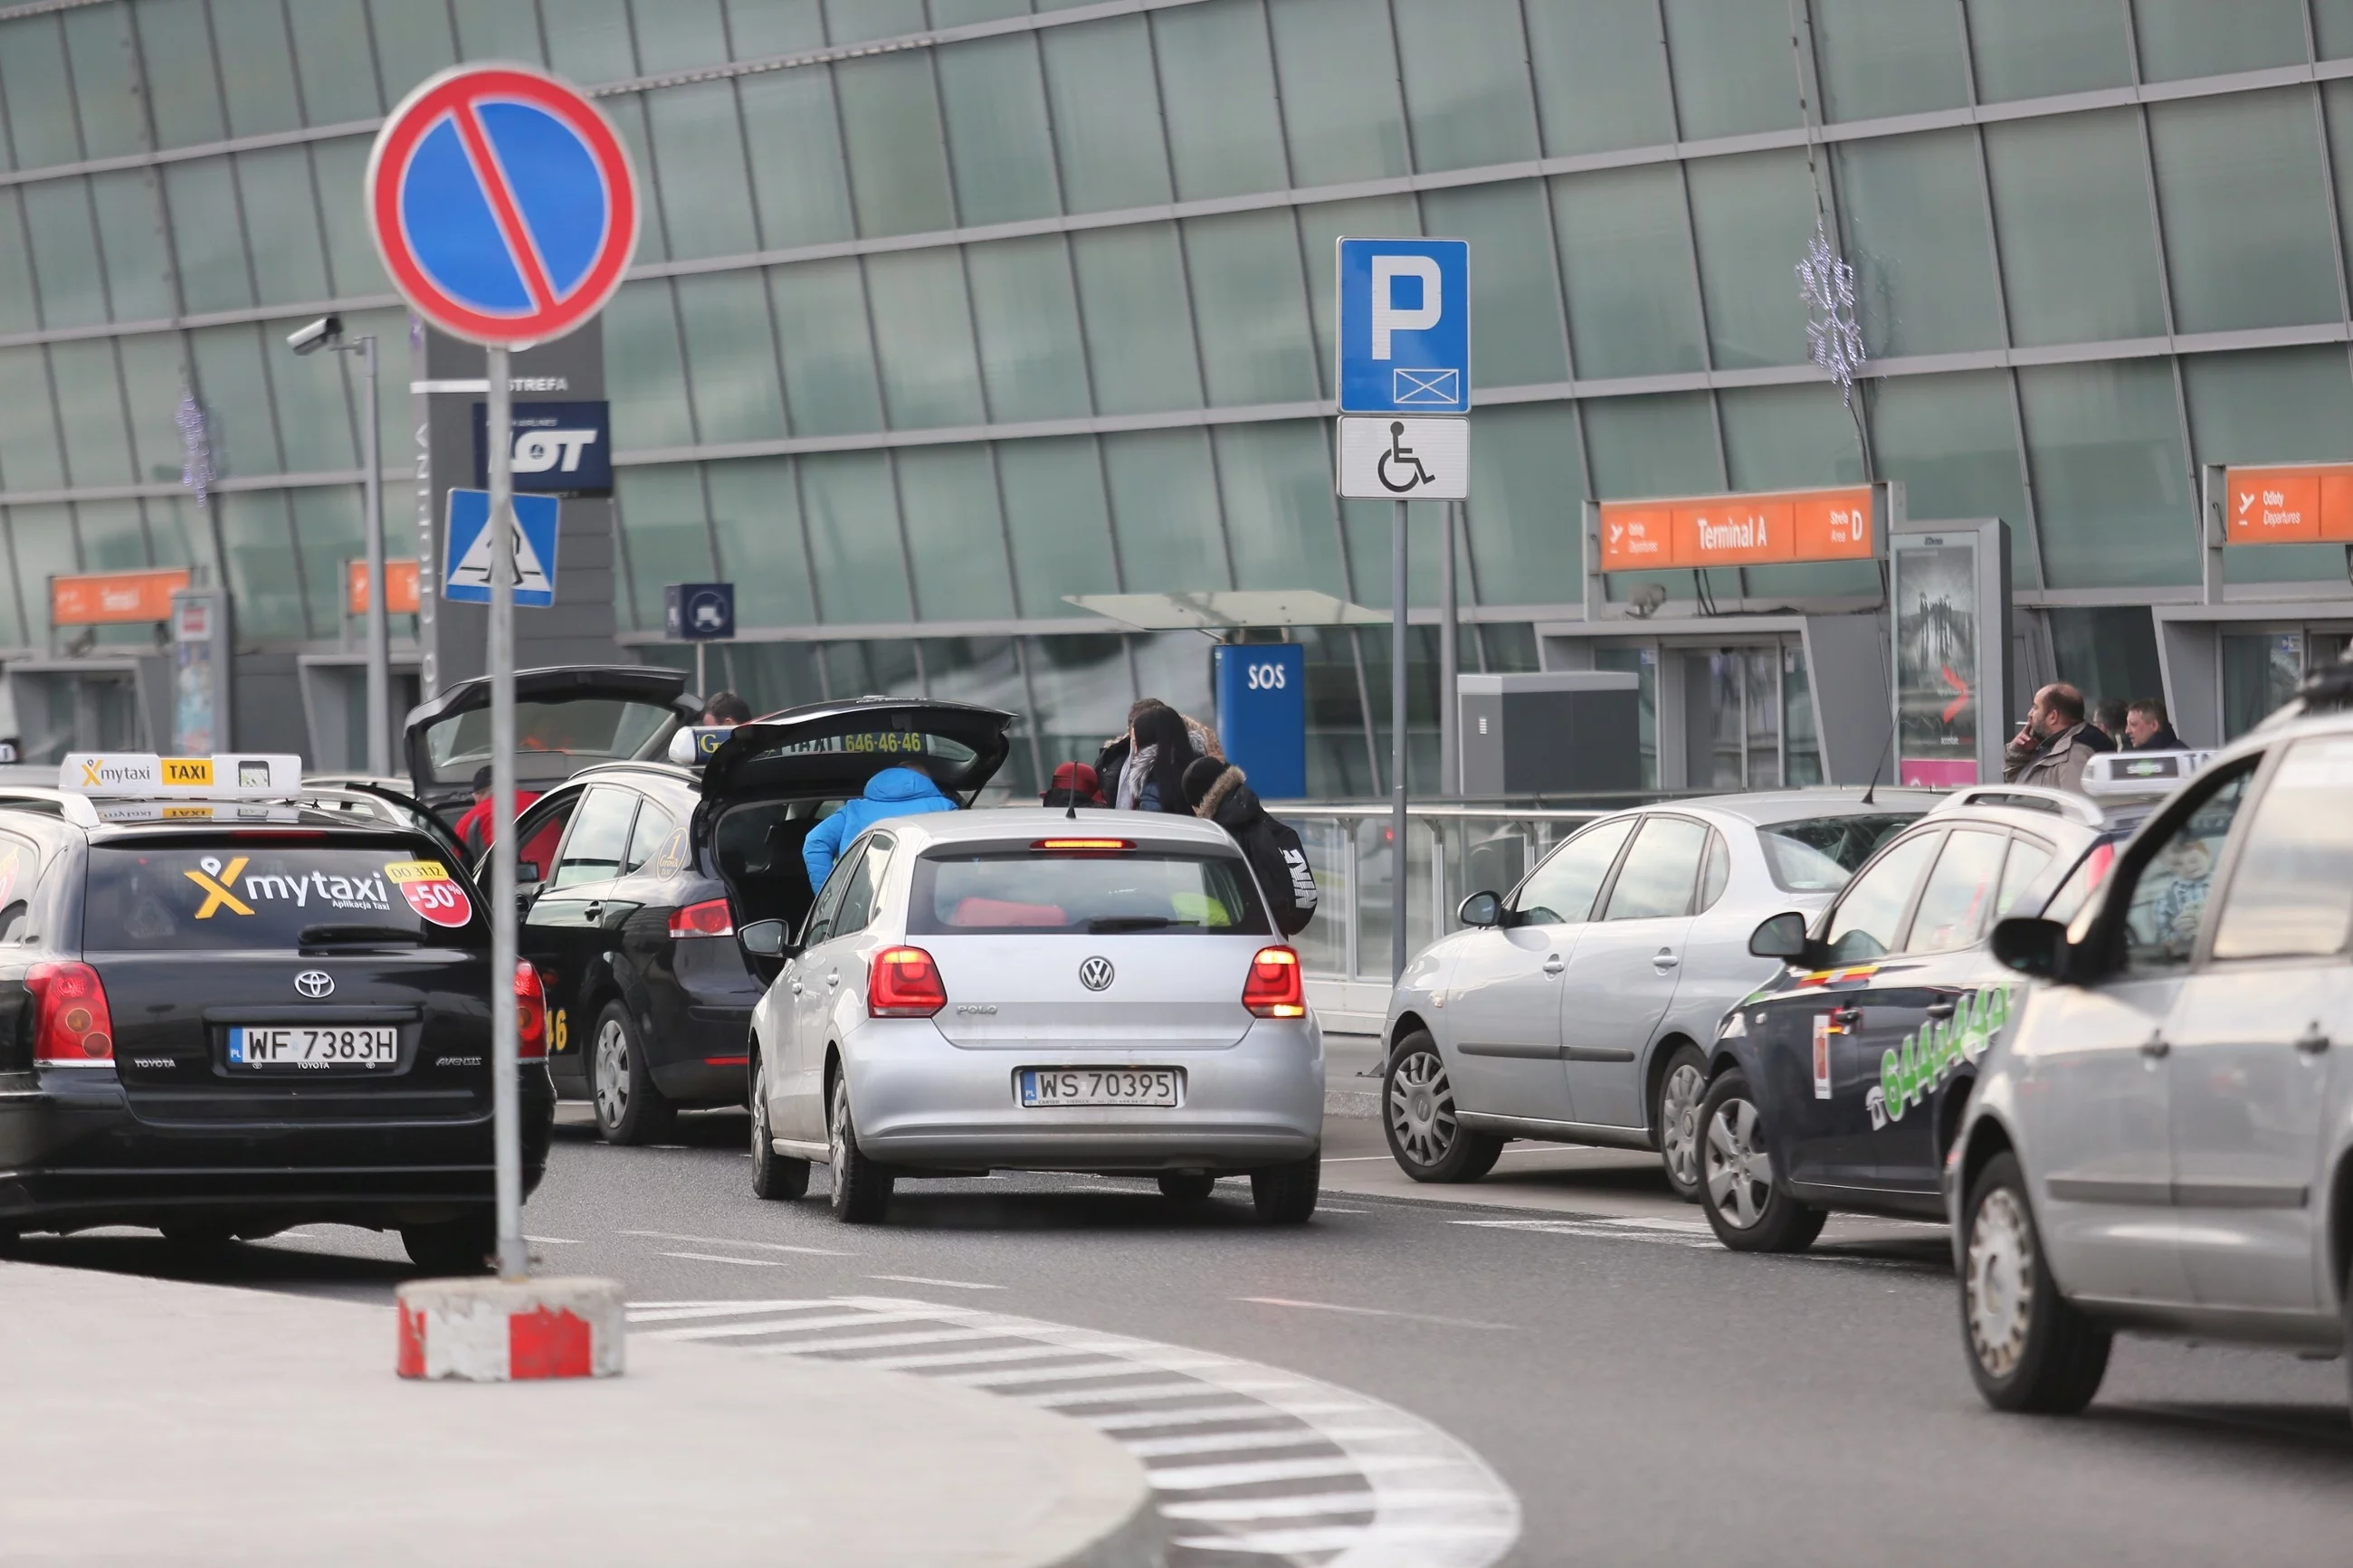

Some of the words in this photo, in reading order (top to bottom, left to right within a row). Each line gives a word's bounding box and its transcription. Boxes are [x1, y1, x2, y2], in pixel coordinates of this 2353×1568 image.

[1372, 255, 1442, 360] P
[1697, 517, 1754, 550] Terminal
[1757, 515, 1767, 547] A
[1852, 508, 1863, 541] D
[1248, 664, 1285, 689] SOS
[101, 765, 150, 784] mytaxi
[169, 765, 205, 780] TAXI
[391, 869, 410, 879] DO
[413, 866, 443, 878] 31.12
[245, 870, 387, 907] mytaxi
[408, 883, 462, 910] -50%
[332, 899, 371, 910] Aplikacja
[373, 902, 390, 911] Taxi
[957, 1004, 997, 1015] POLO
[231, 1050, 242, 1059] PL
[248, 1031, 291, 1060] WF
[303, 1031, 394, 1060] 7383H
[134, 1058, 176, 1069] TOYOTA
[297, 1061, 330, 1069] TOYOTA
[435, 1056, 481, 1066] AVENSIS
[1025, 1089, 1035, 1098] PL
[1041, 1074, 1078, 1098] WS
[1089, 1074, 1170, 1098] 70395
